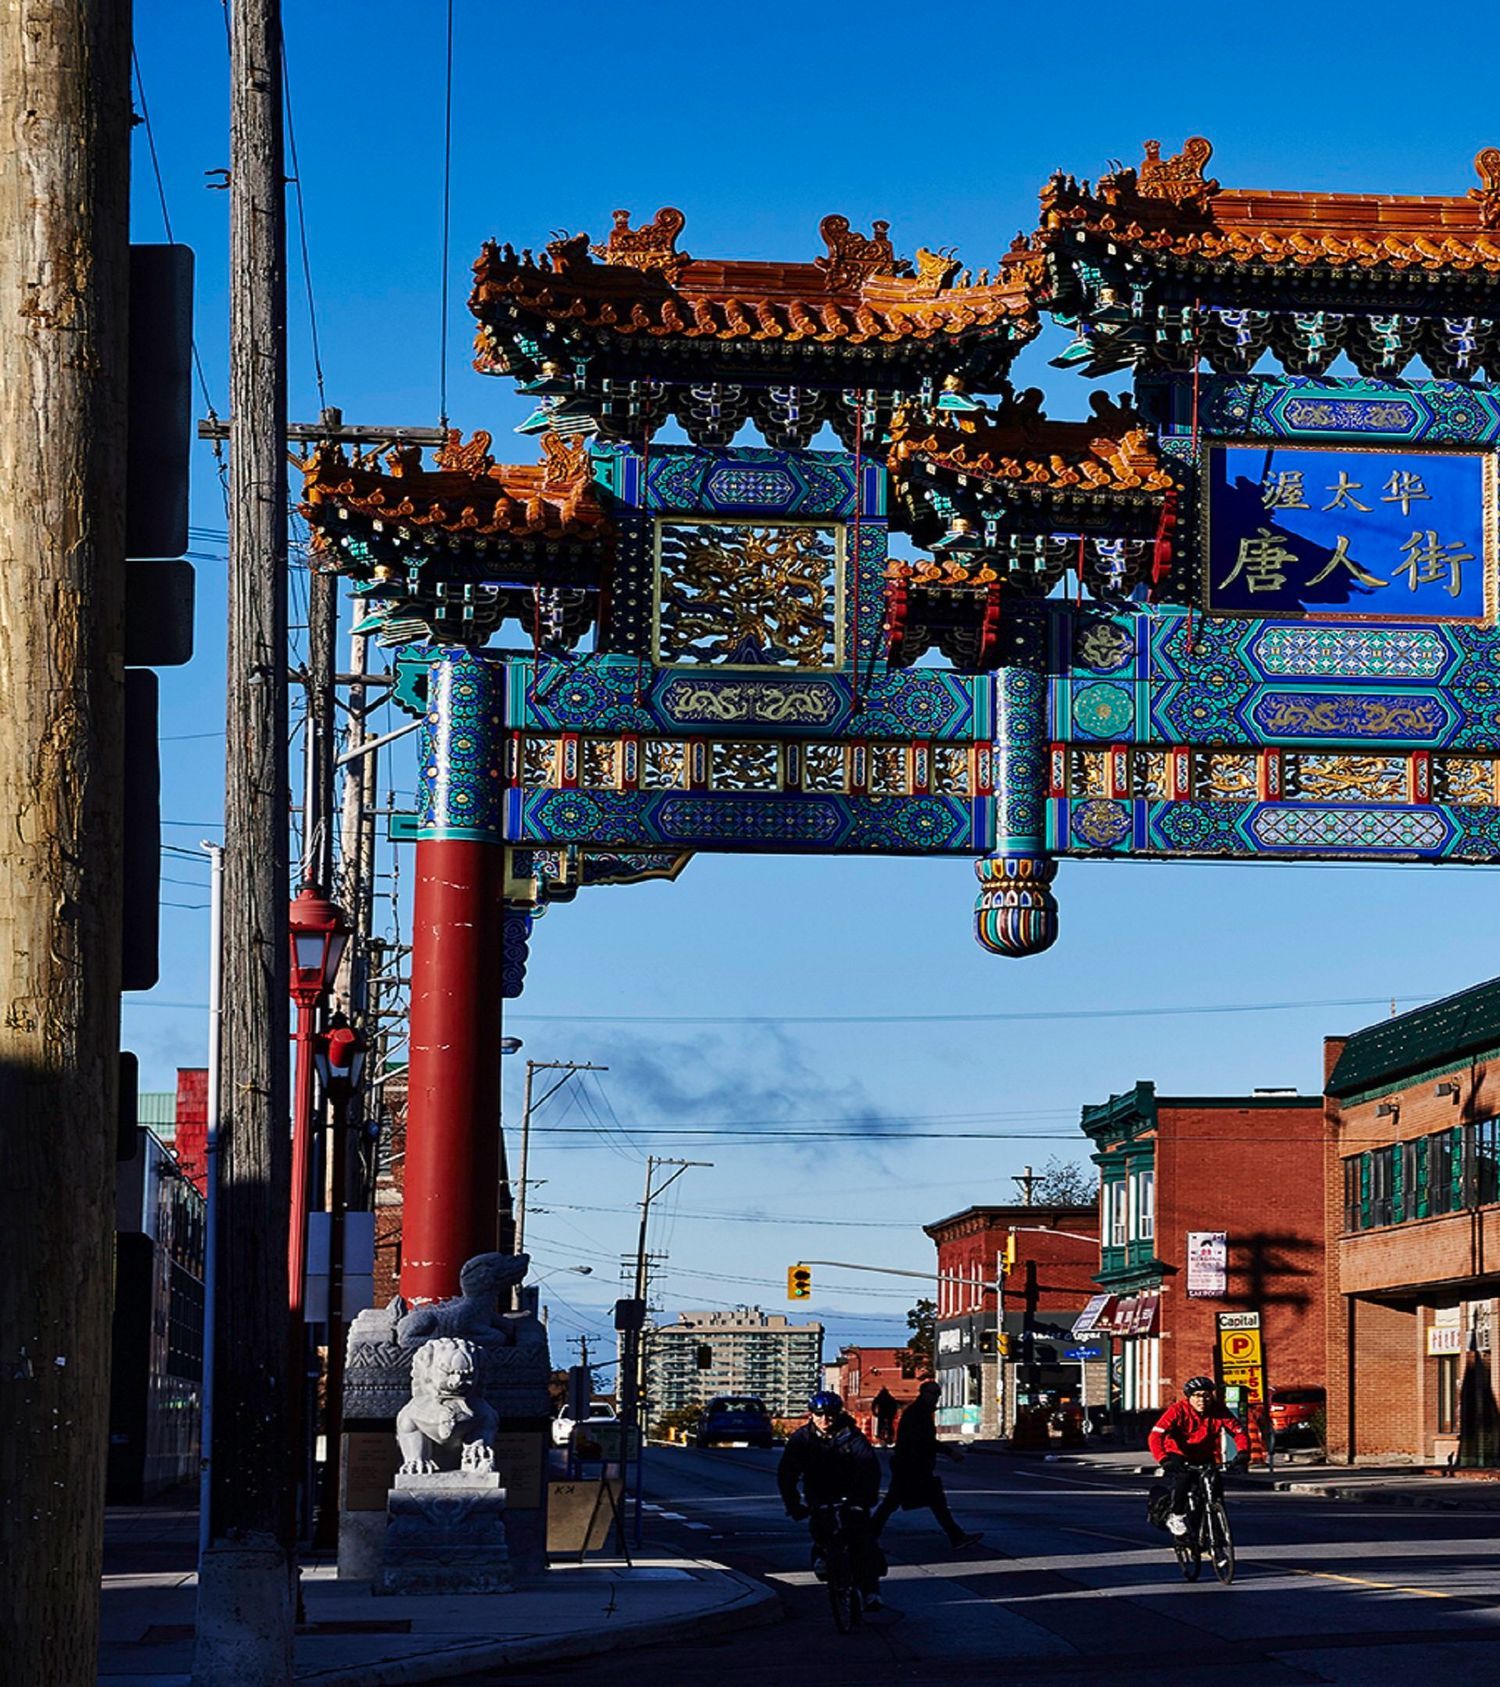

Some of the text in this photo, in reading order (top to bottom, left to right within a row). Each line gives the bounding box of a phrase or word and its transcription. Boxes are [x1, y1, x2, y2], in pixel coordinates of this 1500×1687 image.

[1260, 469, 1433, 516] 渥太华
[1217, 527, 1476, 598] 唐人街
[1220, 1315, 1257, 1328] Capital
[1232, 1338, 1249, 1354] P
